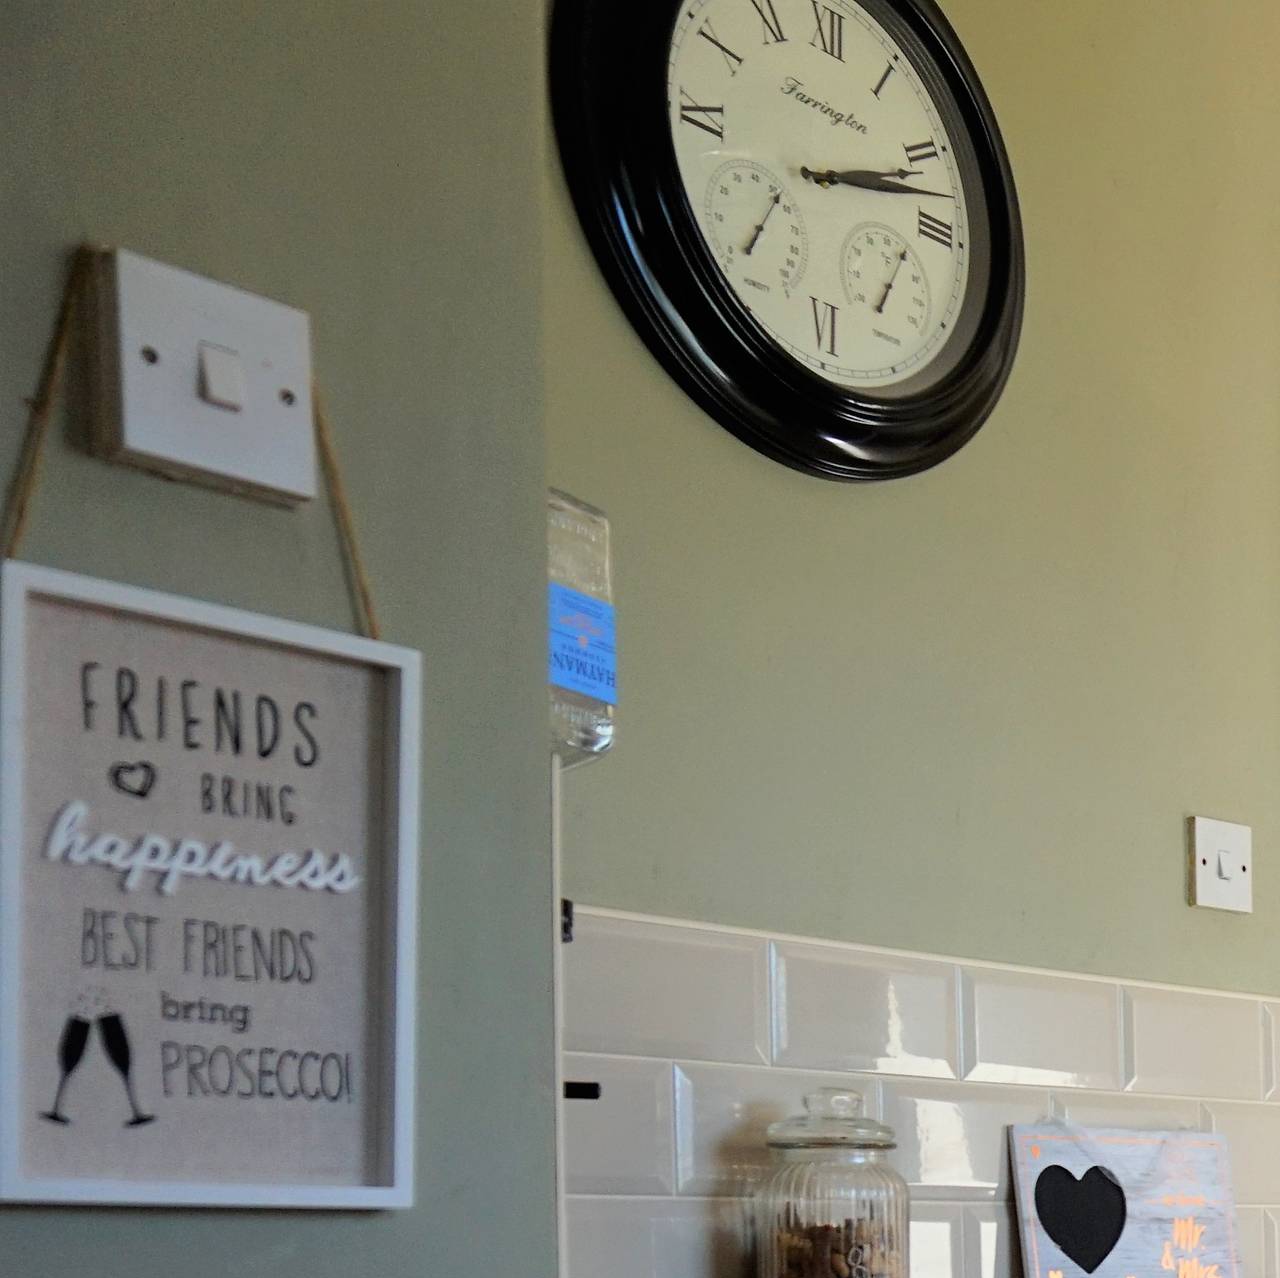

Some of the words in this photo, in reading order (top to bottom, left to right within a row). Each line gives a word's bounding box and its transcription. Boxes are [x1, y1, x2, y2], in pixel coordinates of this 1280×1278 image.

[697, 17, 744, 77] X
[780, 76, 869, 135] Farrington
[809, 296, 840, 358] VI
[80, 661, 320, 768] FRIENDS
[200, 772, 297, 826] BRING
[45, 801, 360, 897] happiness
[81, 908, 161, 973] BEST
[183, 917, 316, 985] FRIENDS
[161, 991, 252, 1033] bring
[161, 1040, 353, 1103] PROSECCO!
